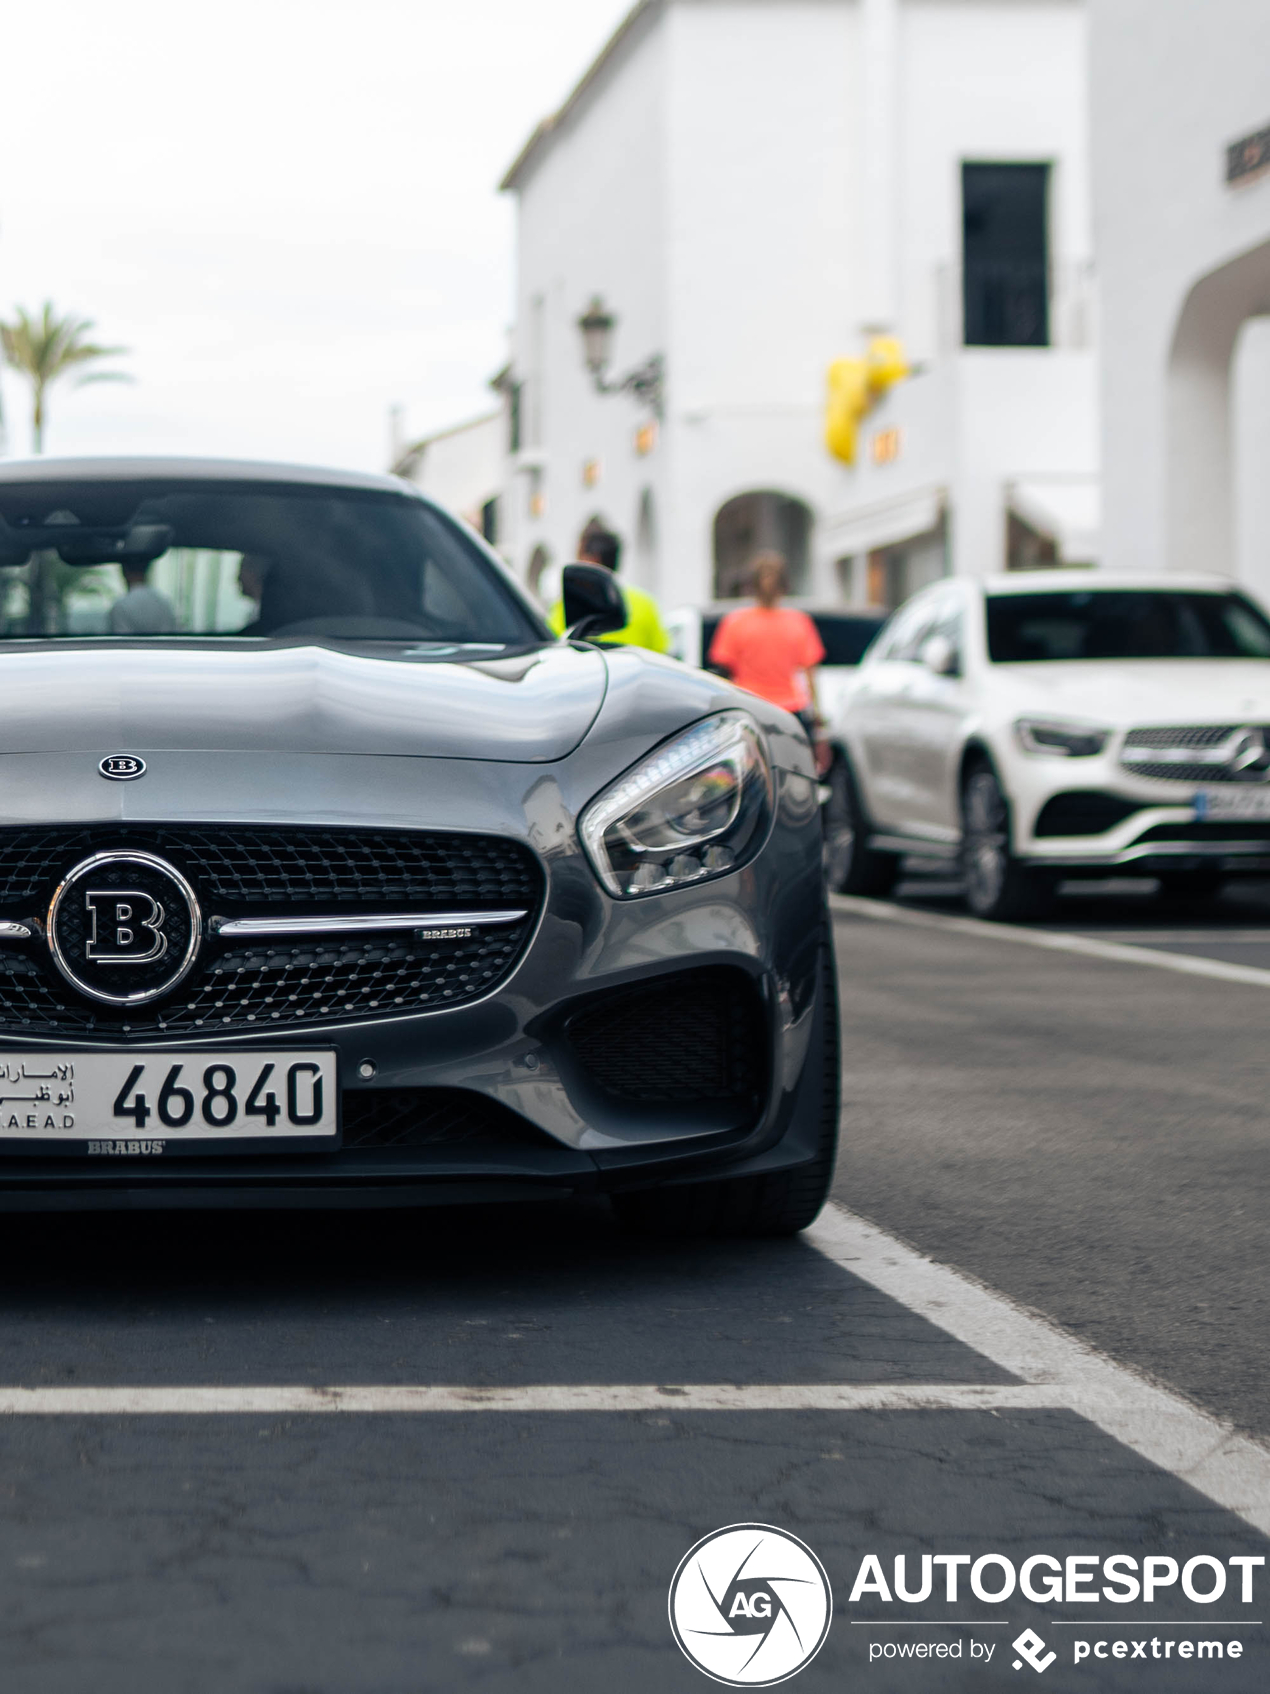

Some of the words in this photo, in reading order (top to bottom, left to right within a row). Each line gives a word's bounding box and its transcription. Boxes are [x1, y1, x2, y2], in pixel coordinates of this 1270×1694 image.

[86, 891, 168, 963] B
[113, 1062, 323, 1128] 46840
[87, 1141, 164, 1155] BRABUS
